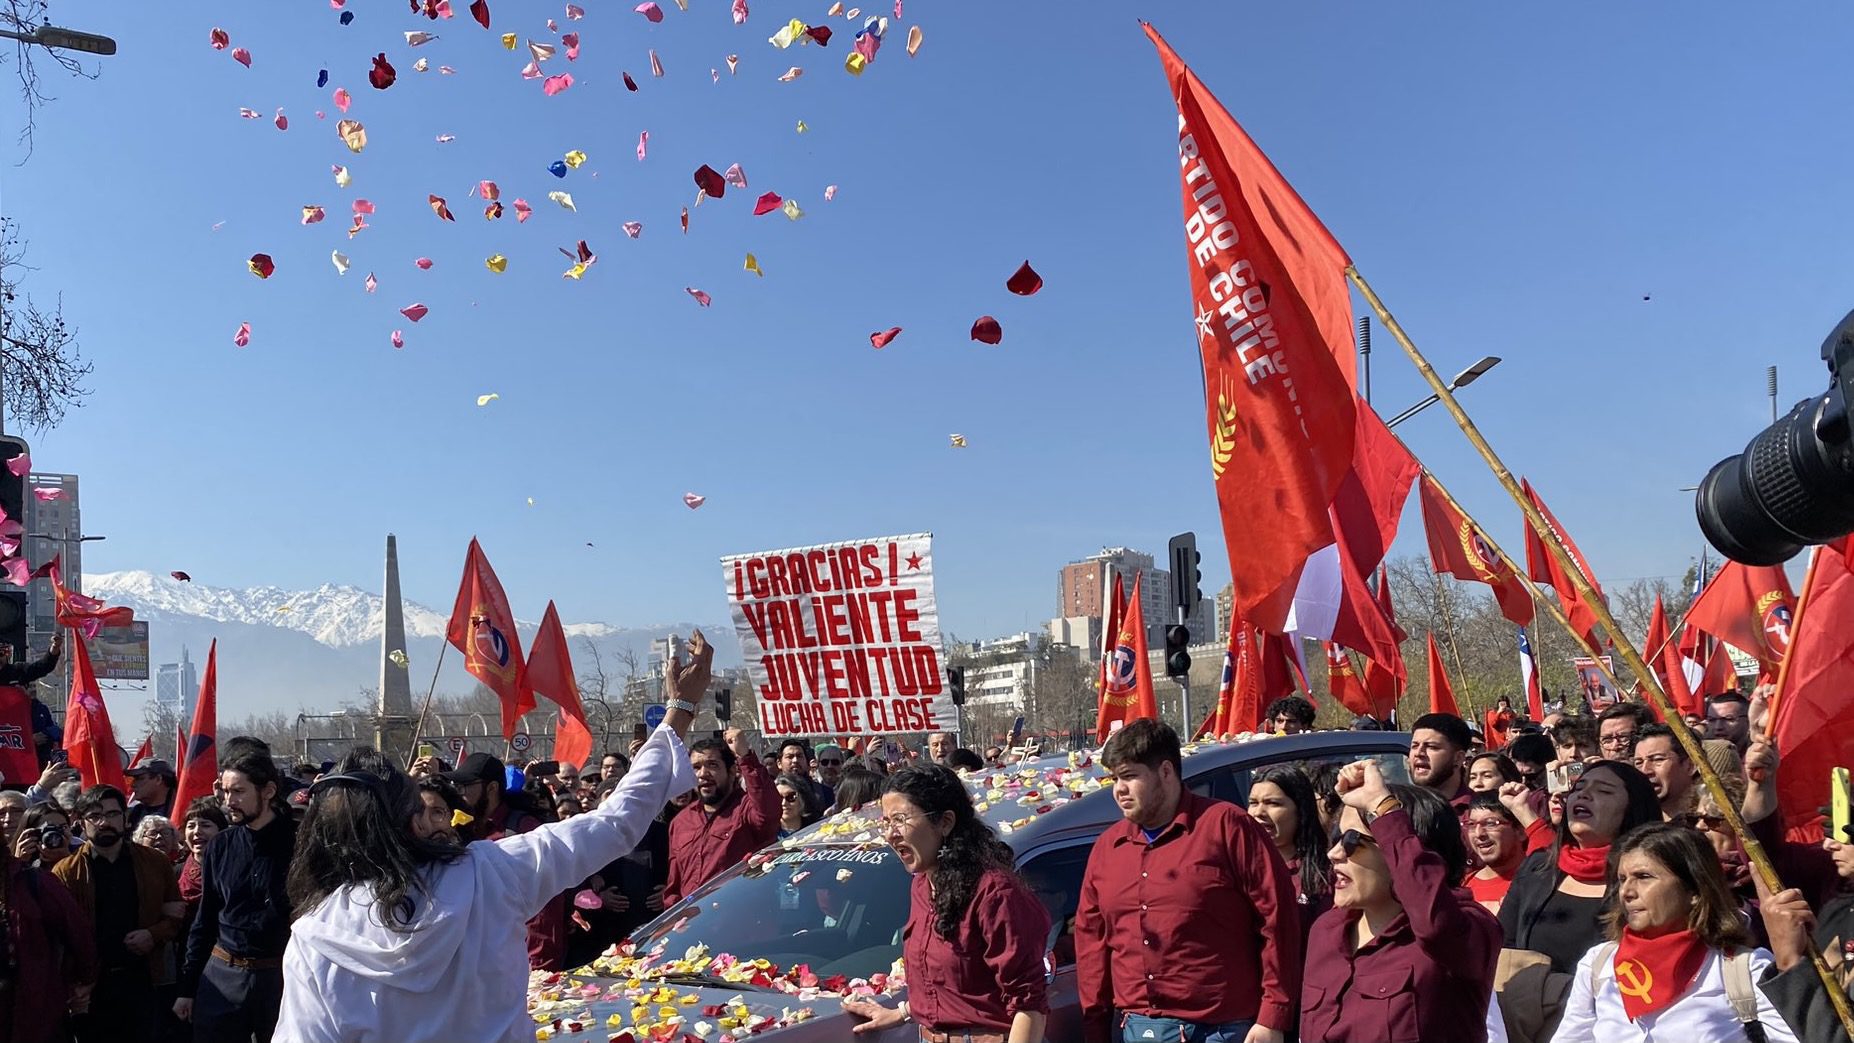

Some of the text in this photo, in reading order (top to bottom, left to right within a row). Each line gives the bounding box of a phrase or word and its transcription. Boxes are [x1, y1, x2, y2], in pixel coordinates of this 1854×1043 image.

[1186, 211, 1276, 386] DE CHILE
[760, 645, 943, 701] JUVENTUD
[760, 697, 941, 735] LUCHA DE CLASE
[453, 741, 461, 750] E
[515, 738, 528, 747] 50
